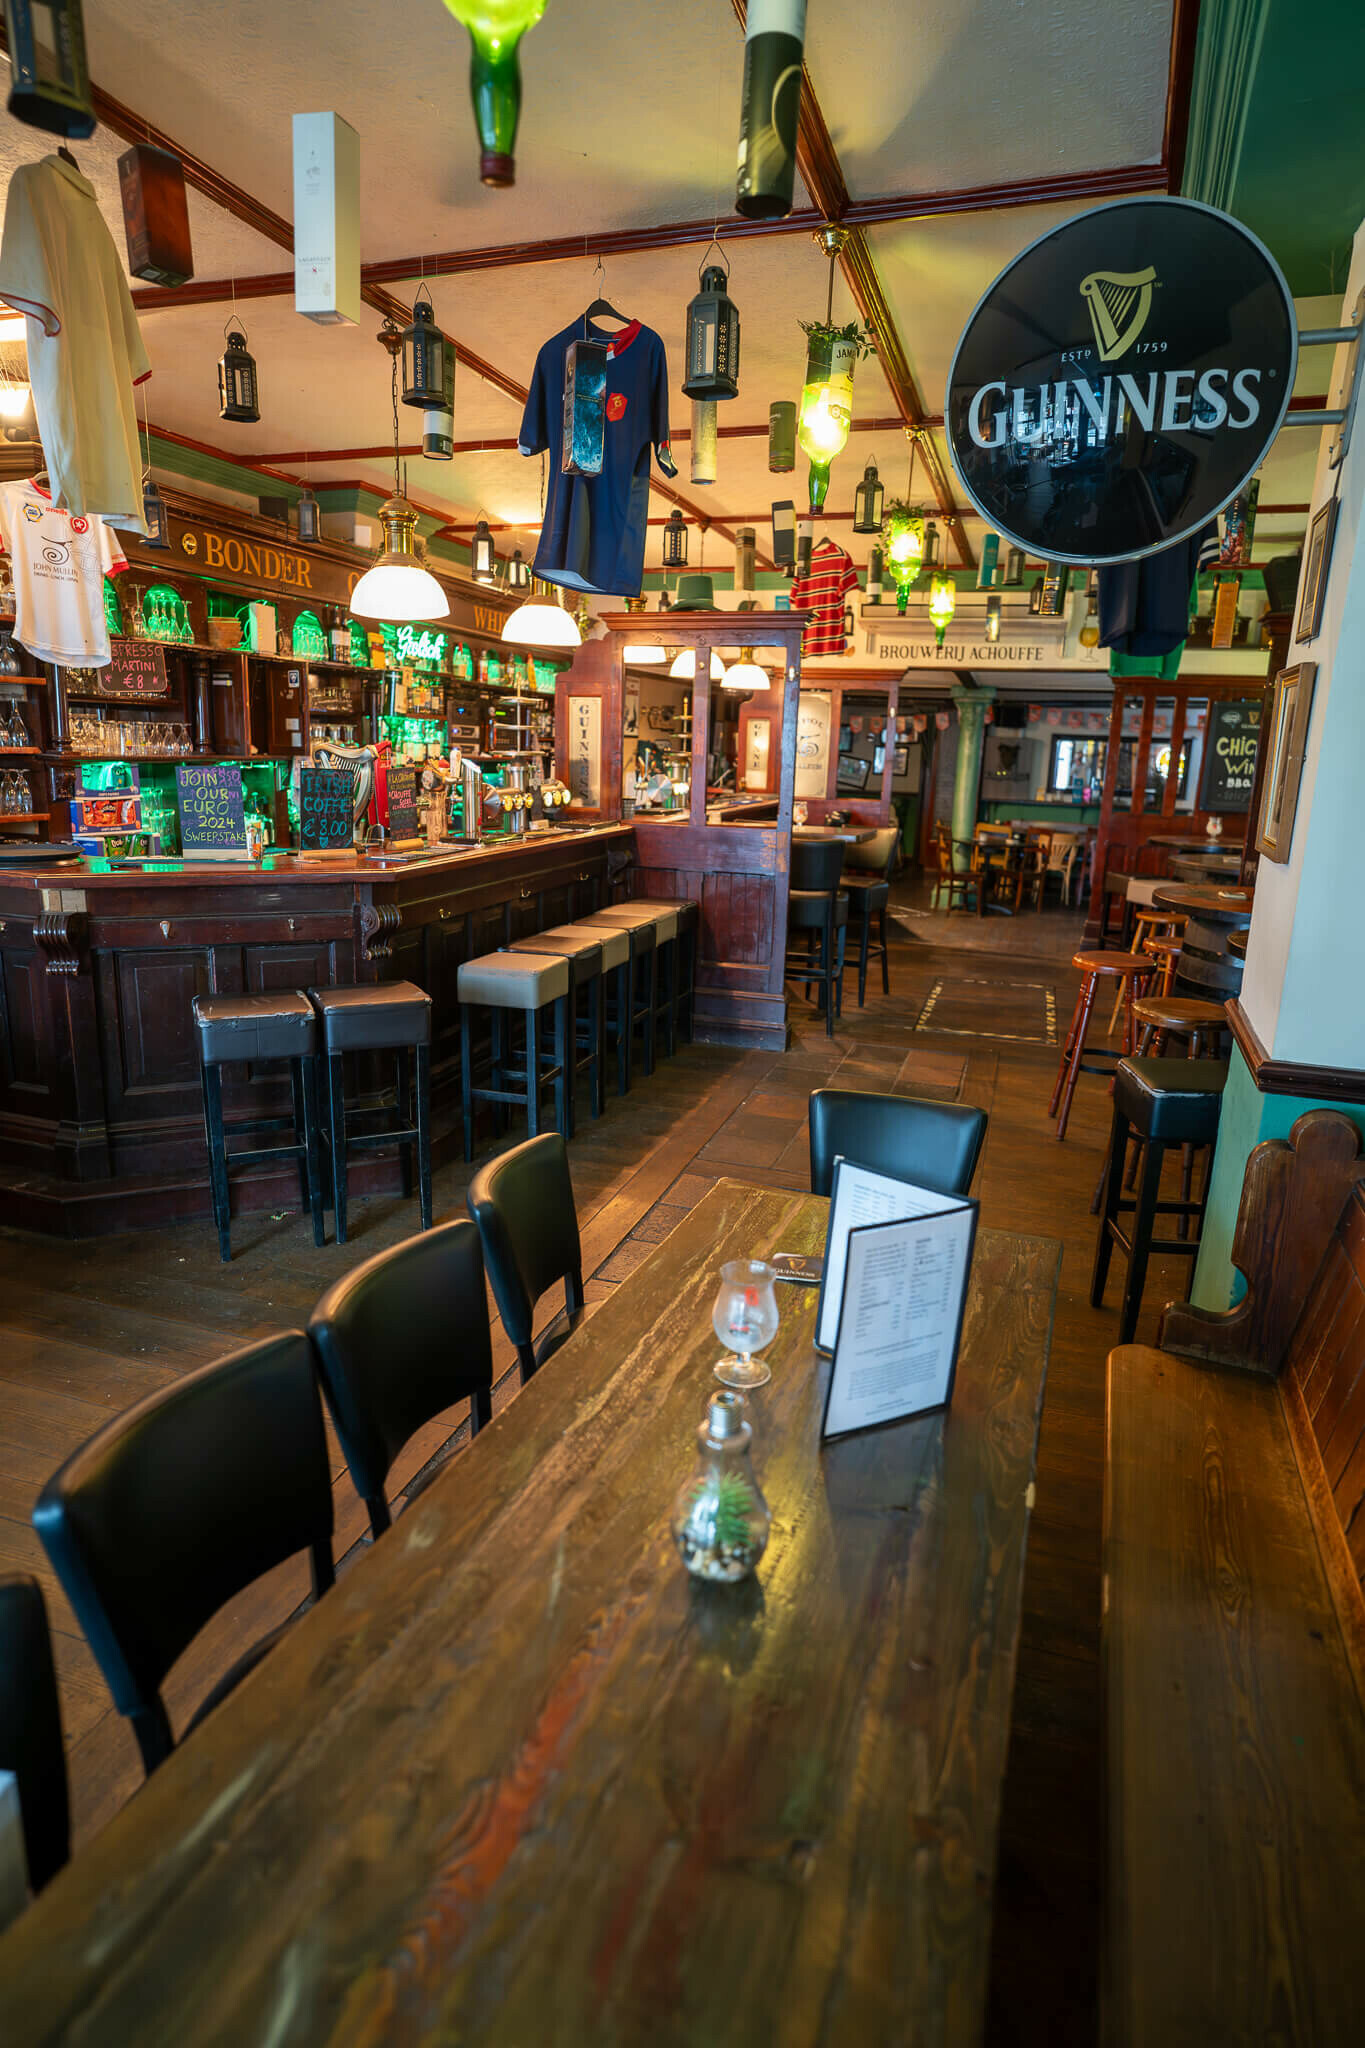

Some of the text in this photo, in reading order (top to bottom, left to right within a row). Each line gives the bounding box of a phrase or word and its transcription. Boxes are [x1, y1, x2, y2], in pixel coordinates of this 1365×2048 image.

[1136, 342, 1168, 353] 1759
[968, 368, 1261, 449] GUINNESS
[203, 532, 313, 589] BONDER
[111, 643, 162, 657] SPRESSO
[879, 645, 1044, 662] BROUWERIJ ACHOUFFE
[111, 659, 156, 672] MARTINI
[180, 768, 218, 787] JOIN
[305, 775, 352, 794] IRISH
[196, 786, 229, 801] OUR
[183, 799, 229, 815] EURO
[198, 815, 236, 829] 2024
[319, 818, 348, 837] 8.00
